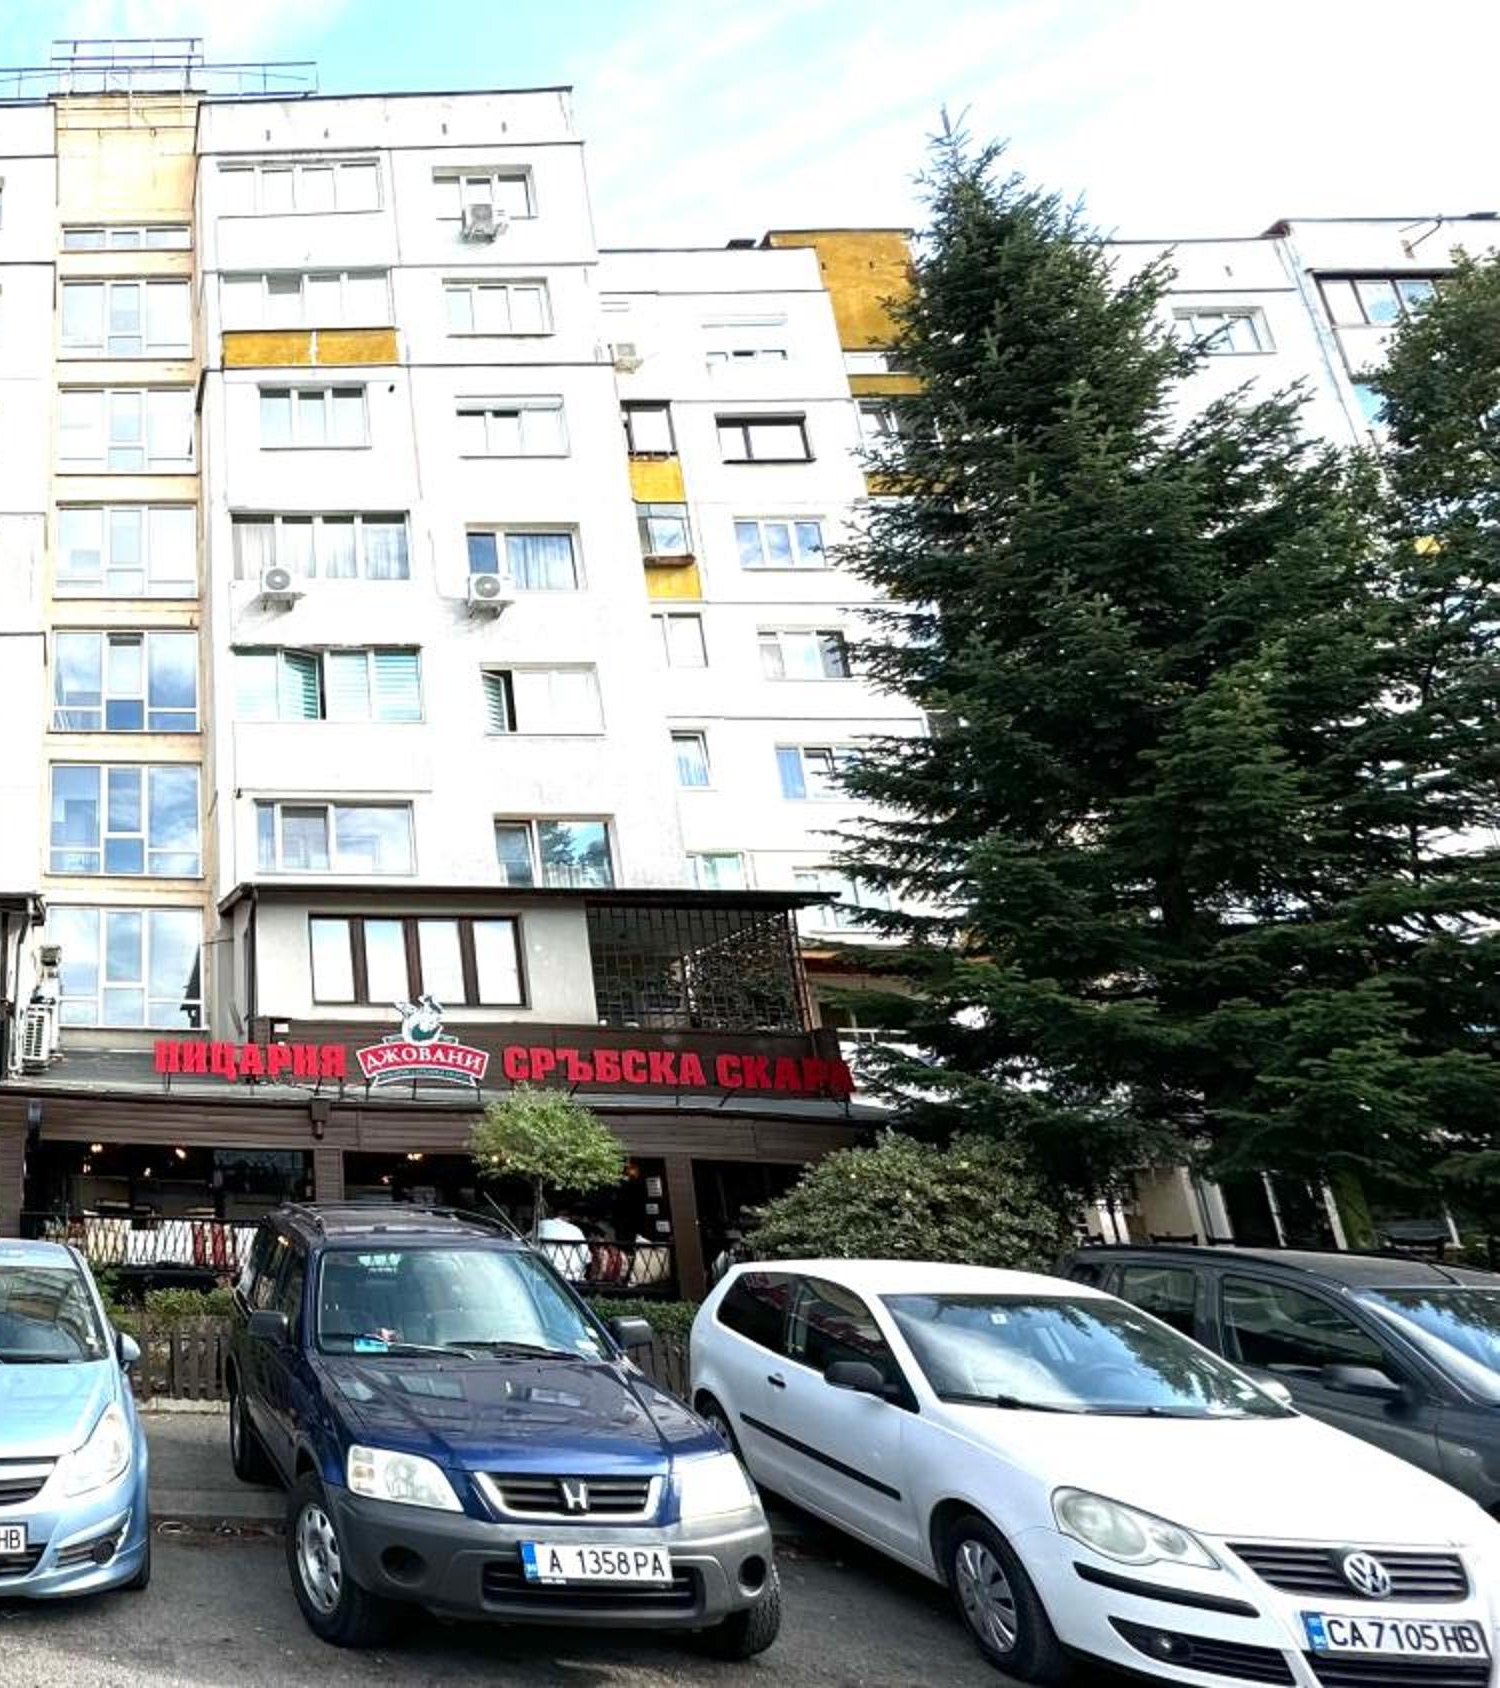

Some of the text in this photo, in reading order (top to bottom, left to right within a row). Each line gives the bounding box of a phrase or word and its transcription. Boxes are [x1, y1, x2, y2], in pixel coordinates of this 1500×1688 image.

[153, 1041, 346, 1081] ПИЦАРИЯ
[367, 1047, 483, 1070] ДЖОВАНИ
[503, 1045, 706, 1086] СРЪБСКА
[550, 1548, 665, 1577] A 1358 PA
[1327, 1619, 1480, 1653] CA 7105 HB
